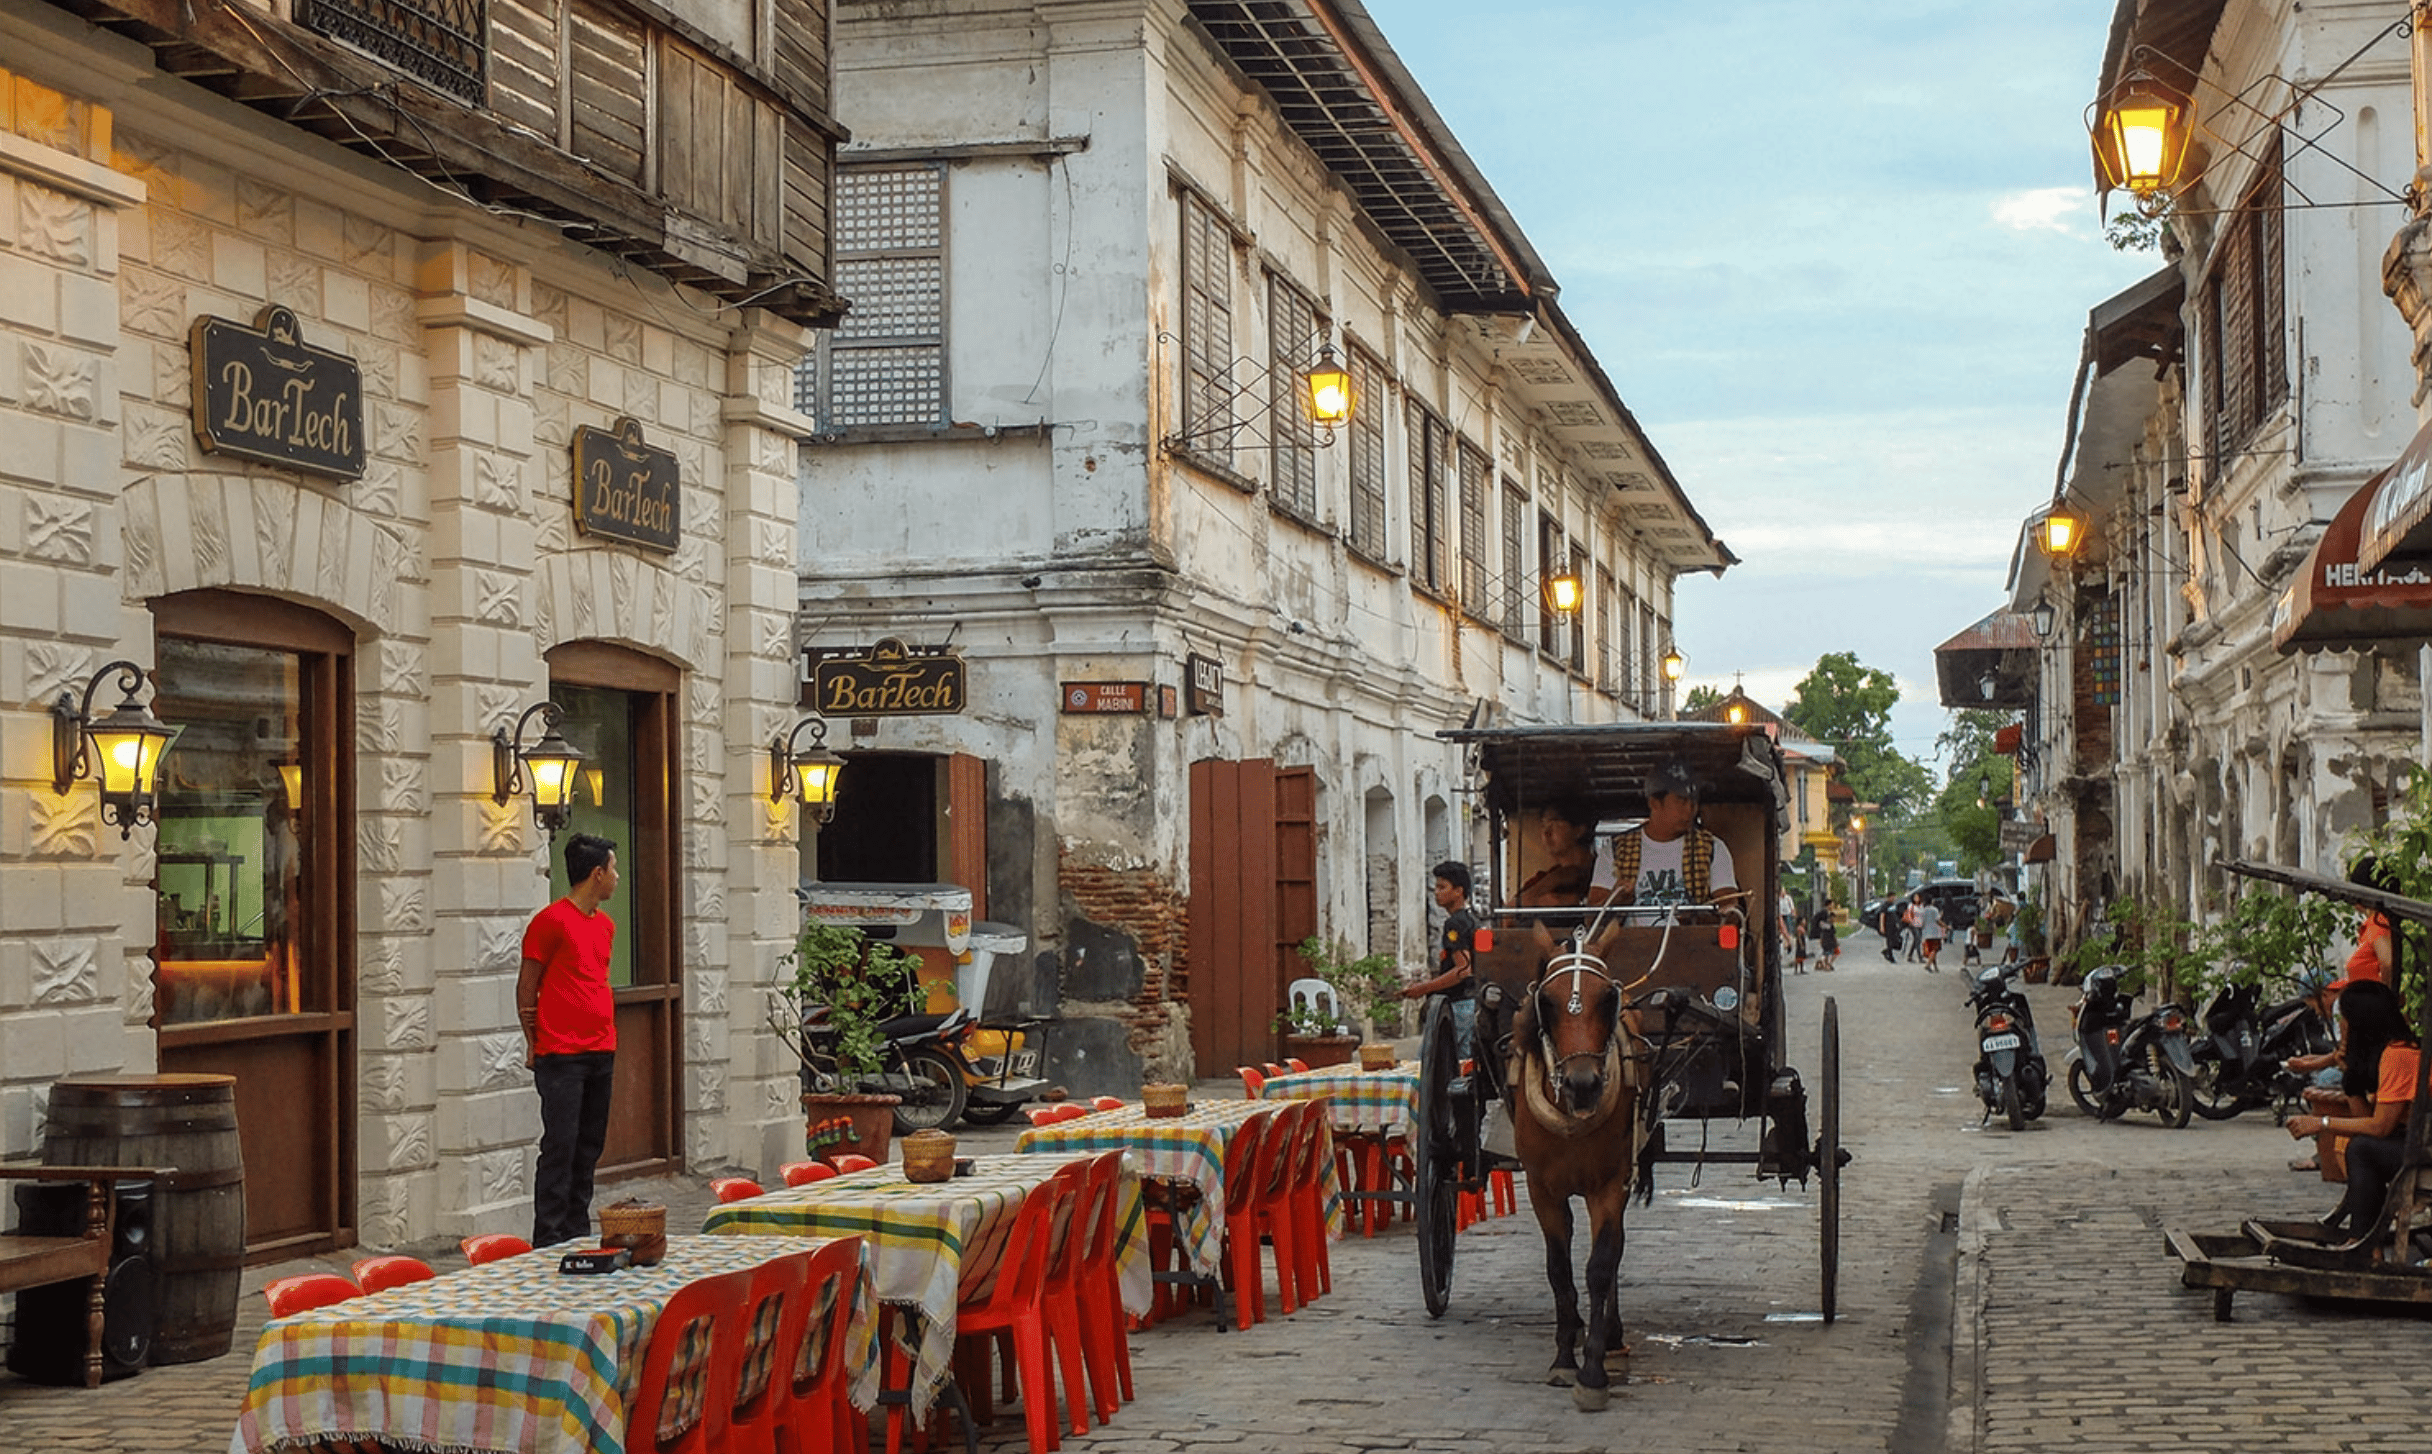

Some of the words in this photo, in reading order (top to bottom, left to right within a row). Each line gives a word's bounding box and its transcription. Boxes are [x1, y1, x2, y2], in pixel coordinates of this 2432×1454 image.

[222, 360, 352, 456] BarTech
[591, 458, 671, 534] BarTech
[826, 668, 954, 709] BarTech
[1097, 698, 1134, 711] MABINI
[1101, 685, 1127, 695] CALLE
